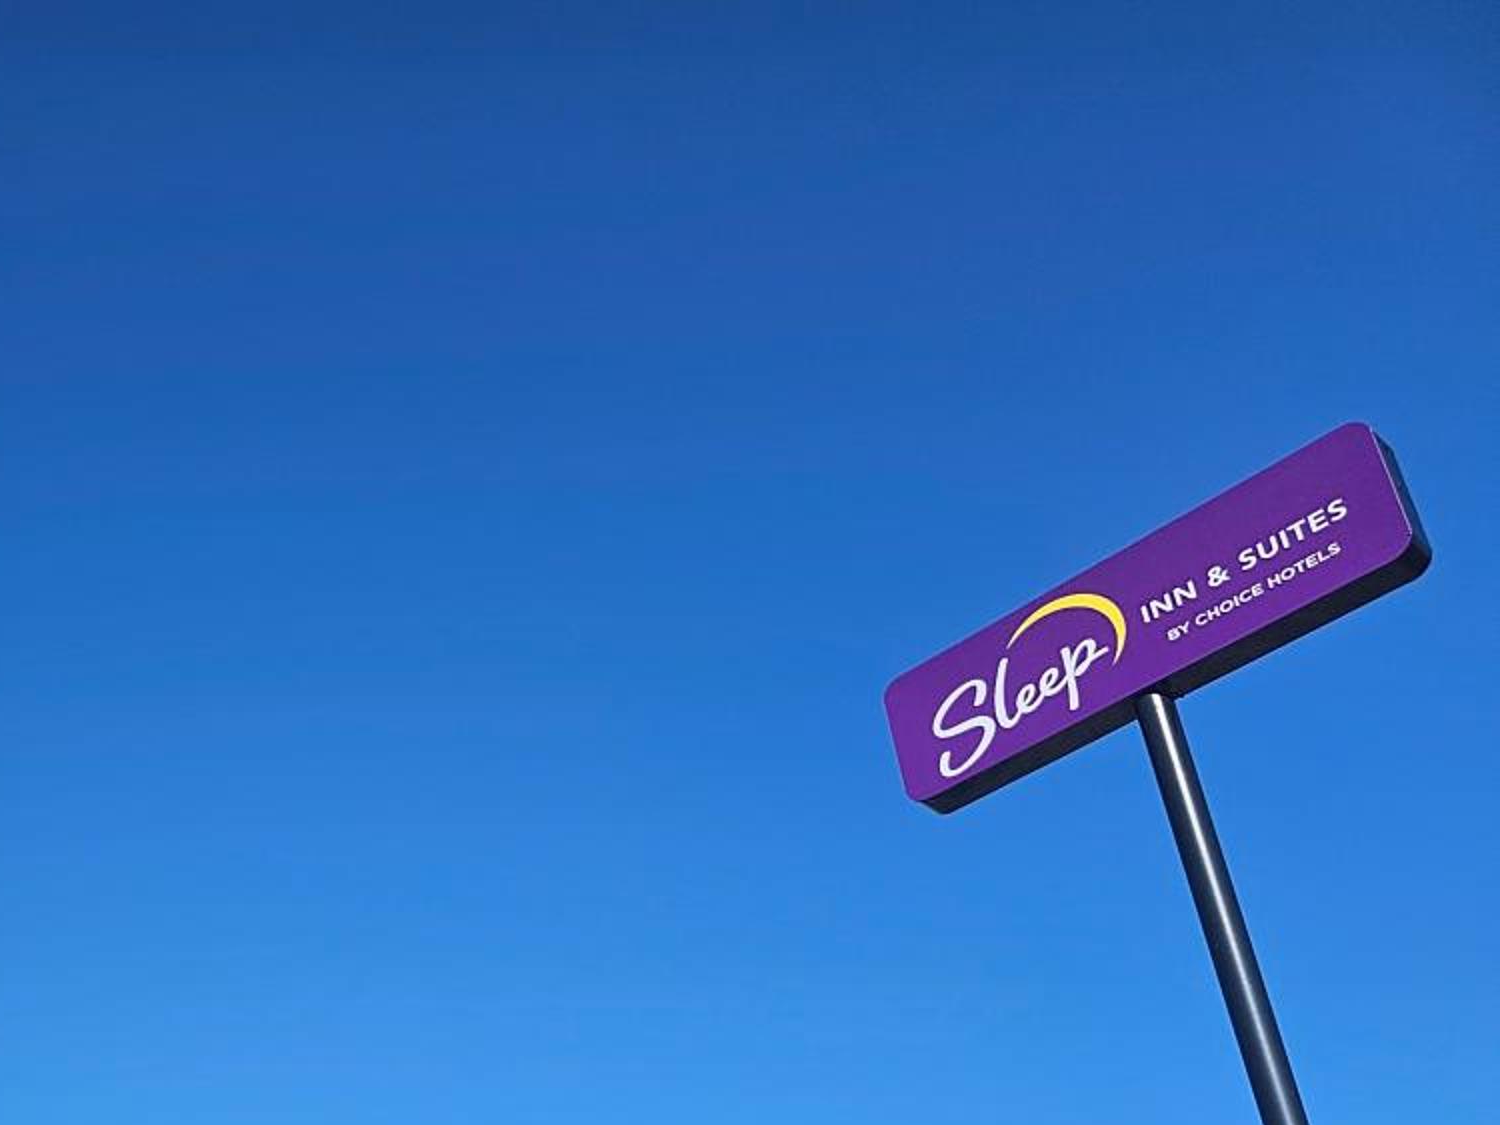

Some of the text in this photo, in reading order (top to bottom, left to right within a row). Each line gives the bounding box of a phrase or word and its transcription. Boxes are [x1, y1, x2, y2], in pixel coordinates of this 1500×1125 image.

[1140, 498, 1348, 623] INN & SUITES
[1167, 541, 1342, 641] BY CHOICE HOTELS
[932, 638, 1110, 778] Sleep
